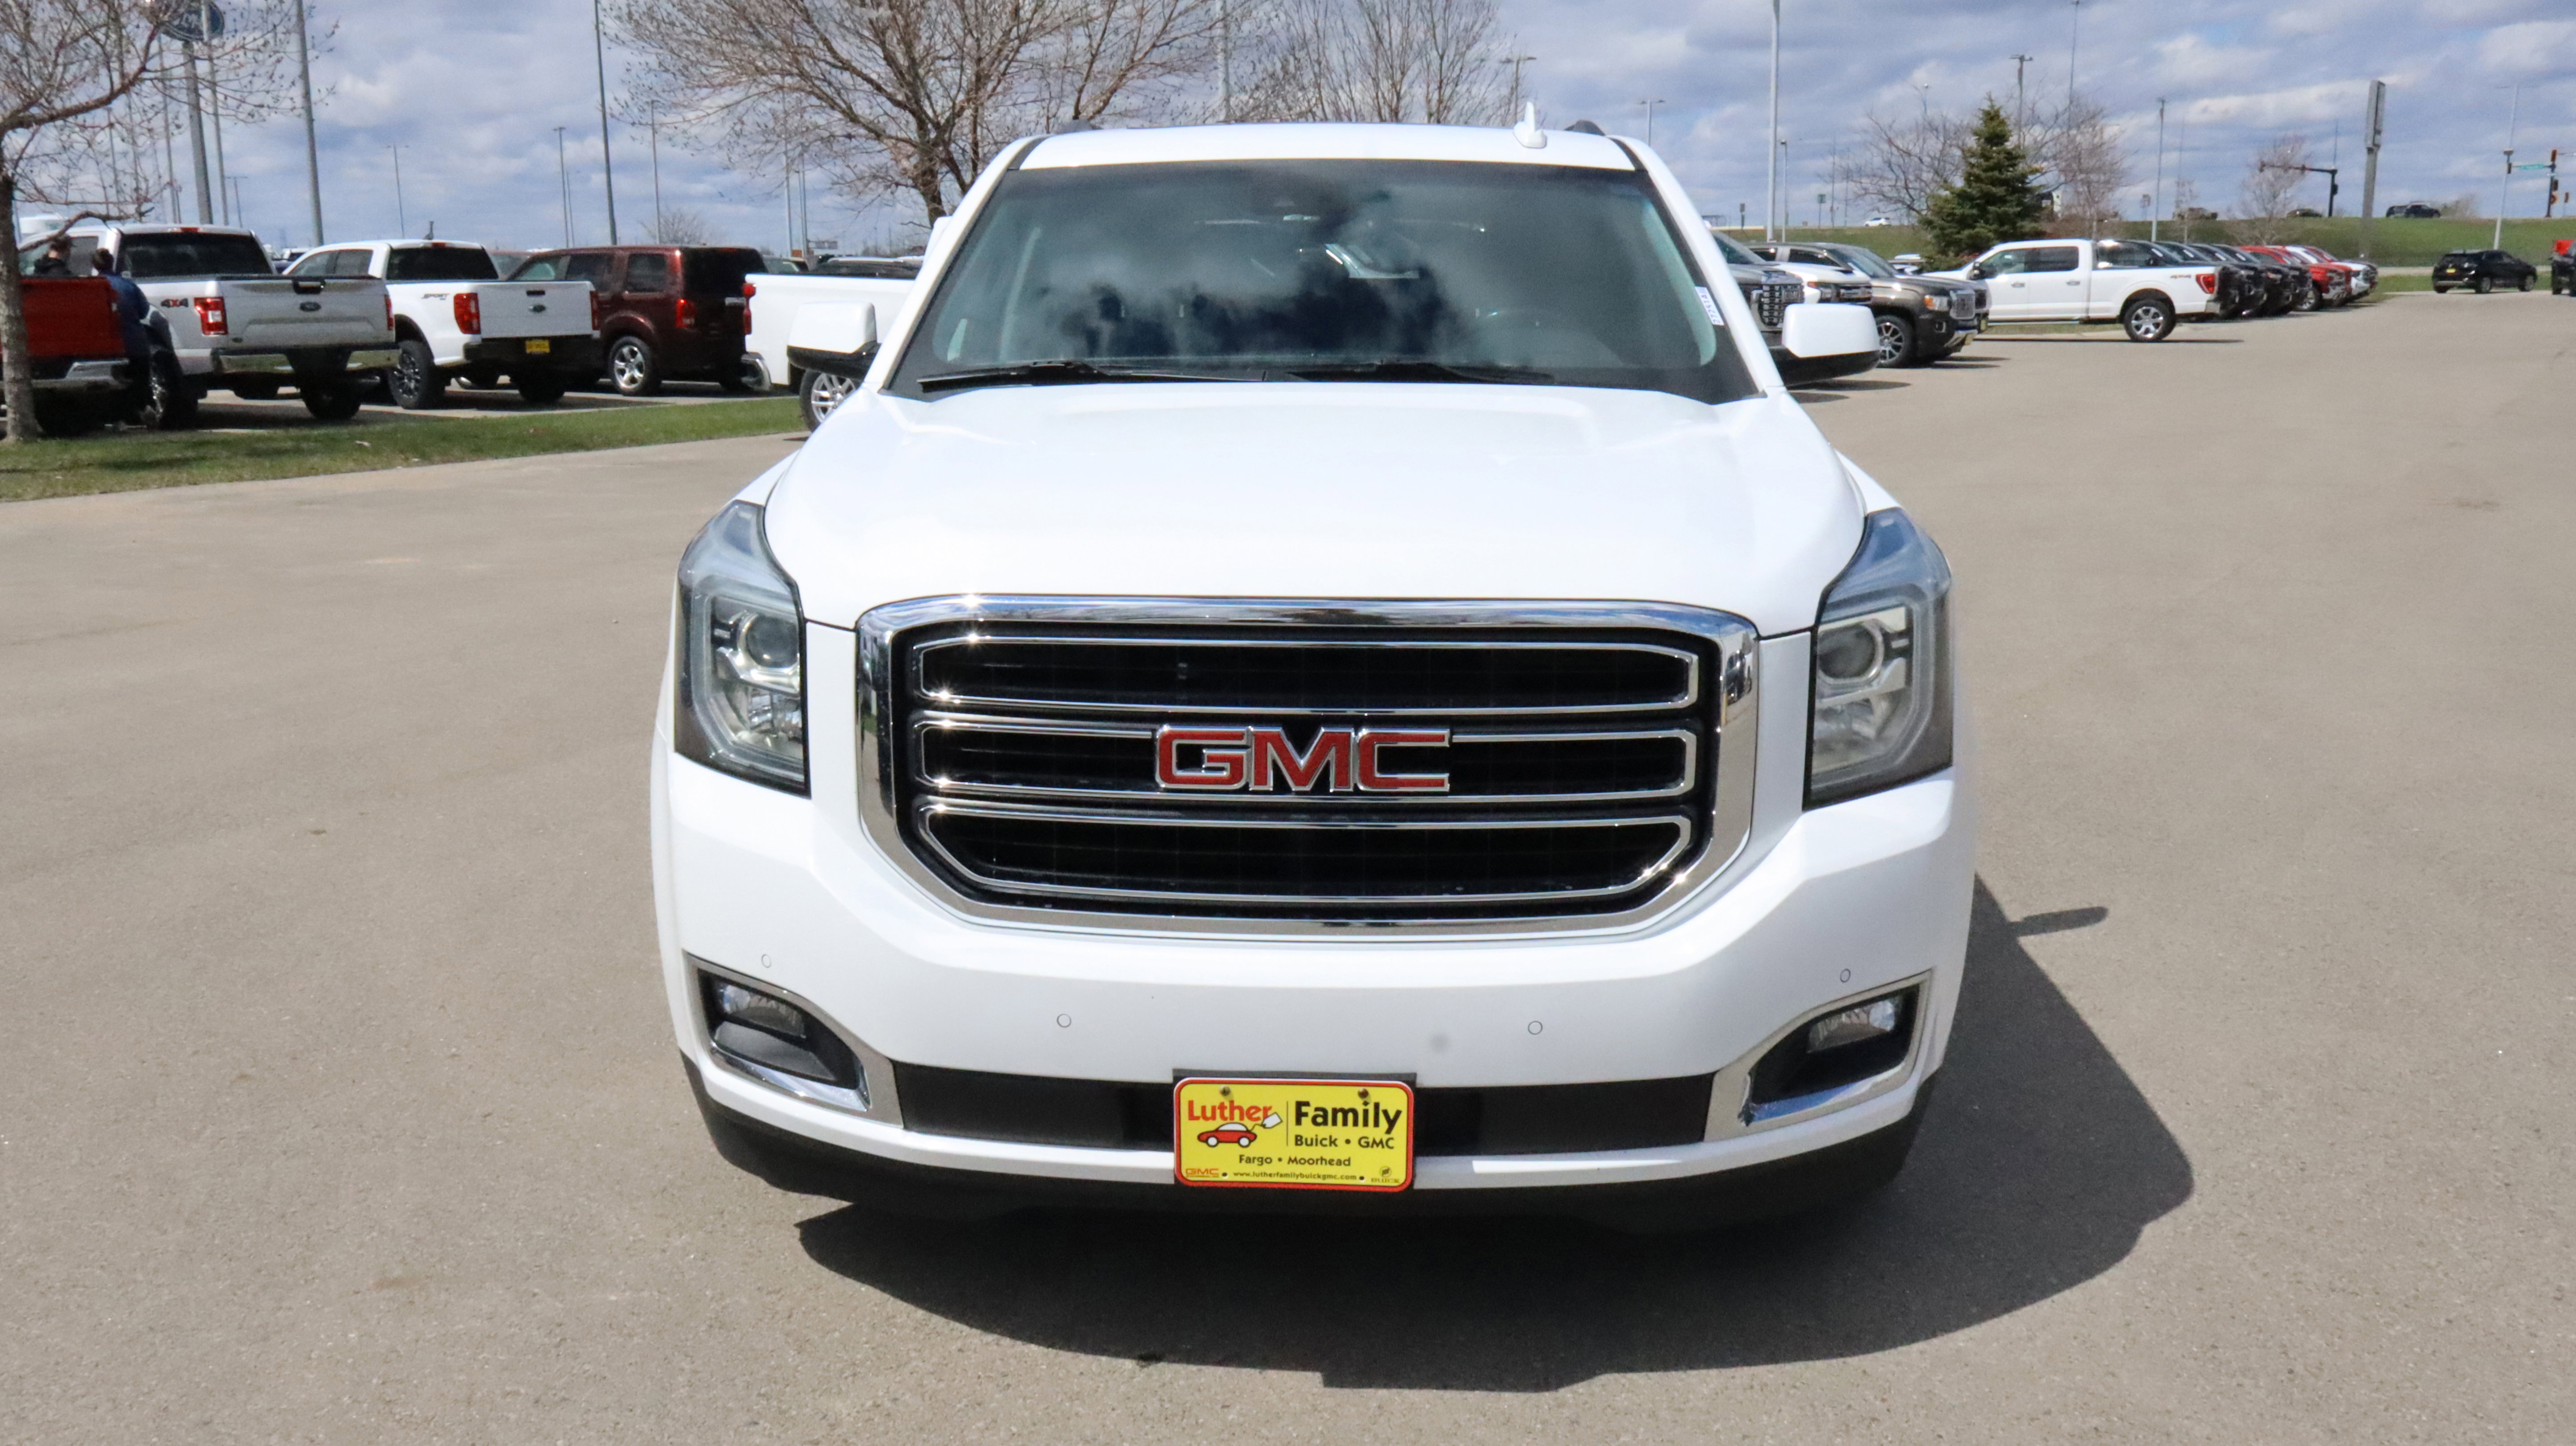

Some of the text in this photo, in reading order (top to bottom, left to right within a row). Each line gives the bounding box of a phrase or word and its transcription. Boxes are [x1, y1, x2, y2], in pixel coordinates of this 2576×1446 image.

[1156, 725, 1450, 792] GMC
[1188, 1100, 1272, 1122] Luther
[1295, 1100, 1402, 1135] Family
[1295, 1134, 1395, 1149] Buick GMC
[1239, 1154, 1351, 1166] Fargo Moorhead
[1233, 1171, 1357, 1181] www.lutherfamilybuickgmc.com
